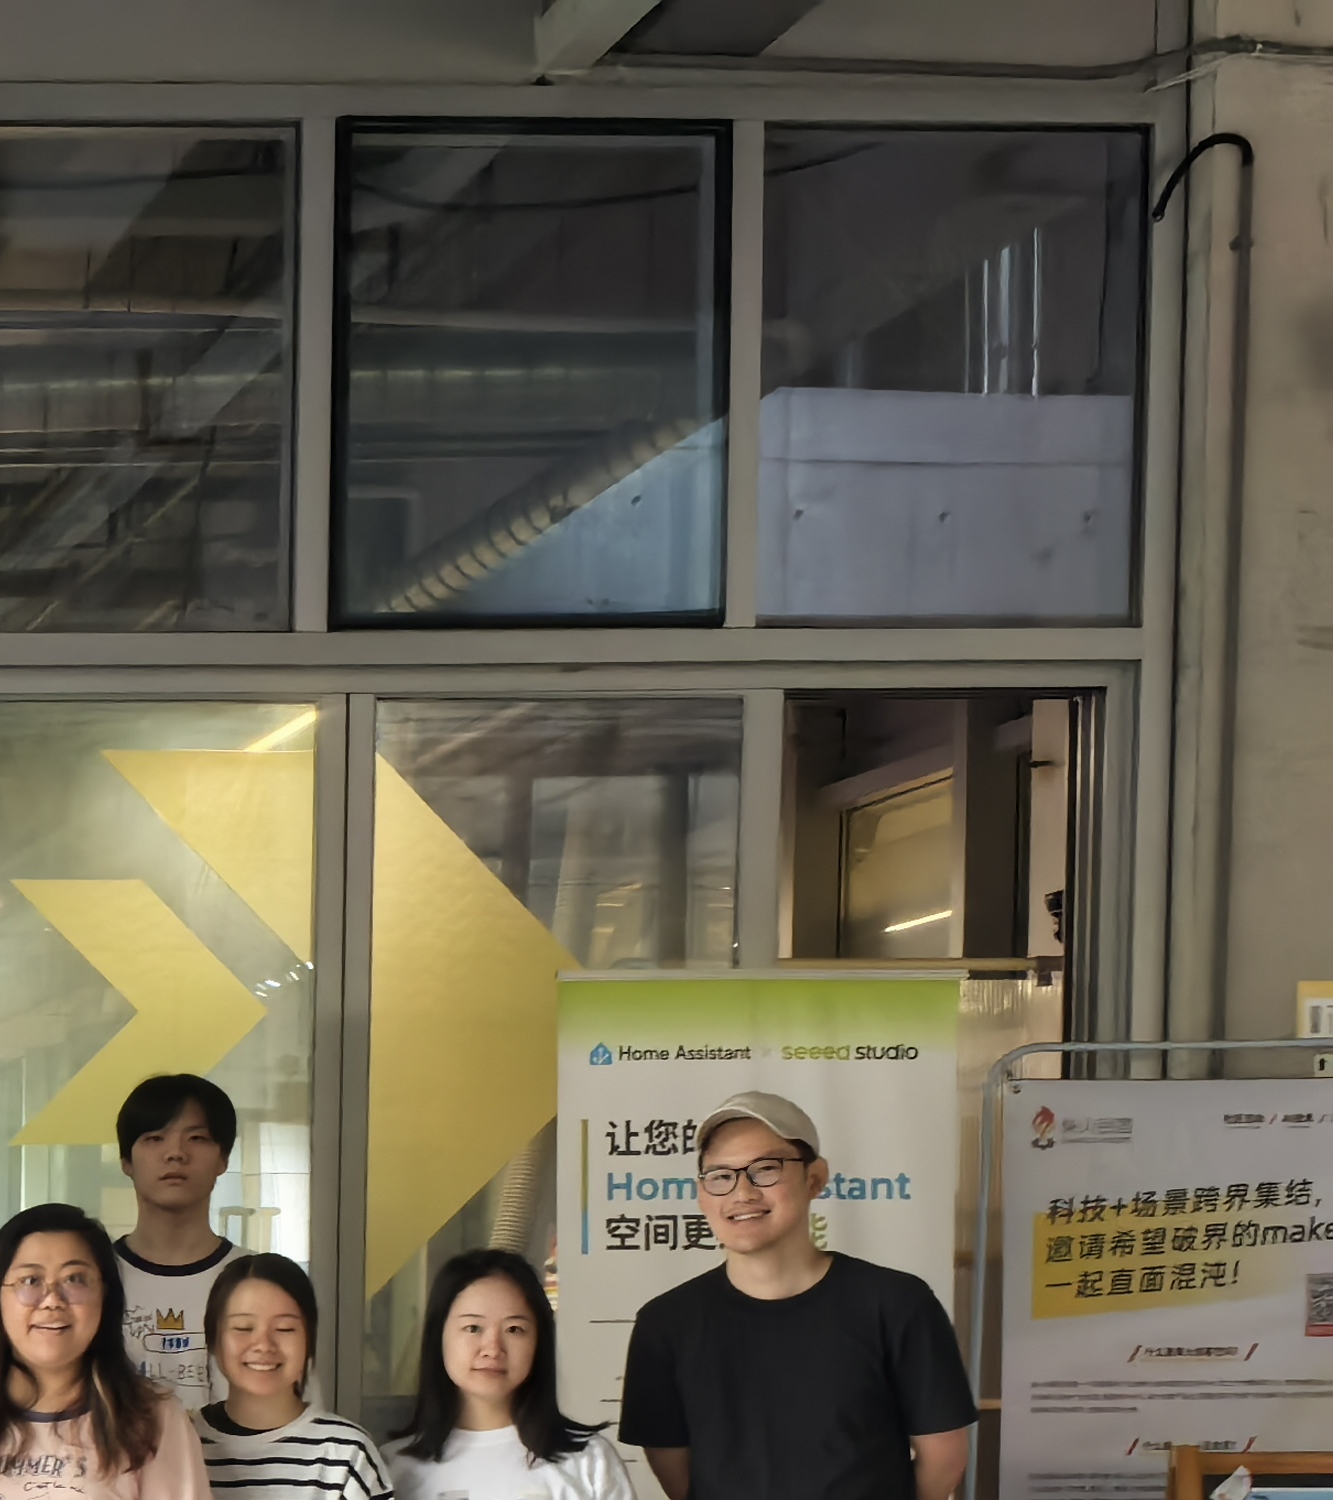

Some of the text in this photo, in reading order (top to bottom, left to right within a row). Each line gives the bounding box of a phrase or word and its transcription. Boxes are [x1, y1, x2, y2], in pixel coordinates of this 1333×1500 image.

[618, 1045, 670, 1061] Home
[674, 1044, 752, 1061] Assistant
[781, 1044, 850, 1061] seeed
[854, 1043, 919, 1061] studio
[606, 1171, 697, 1201] Hom
